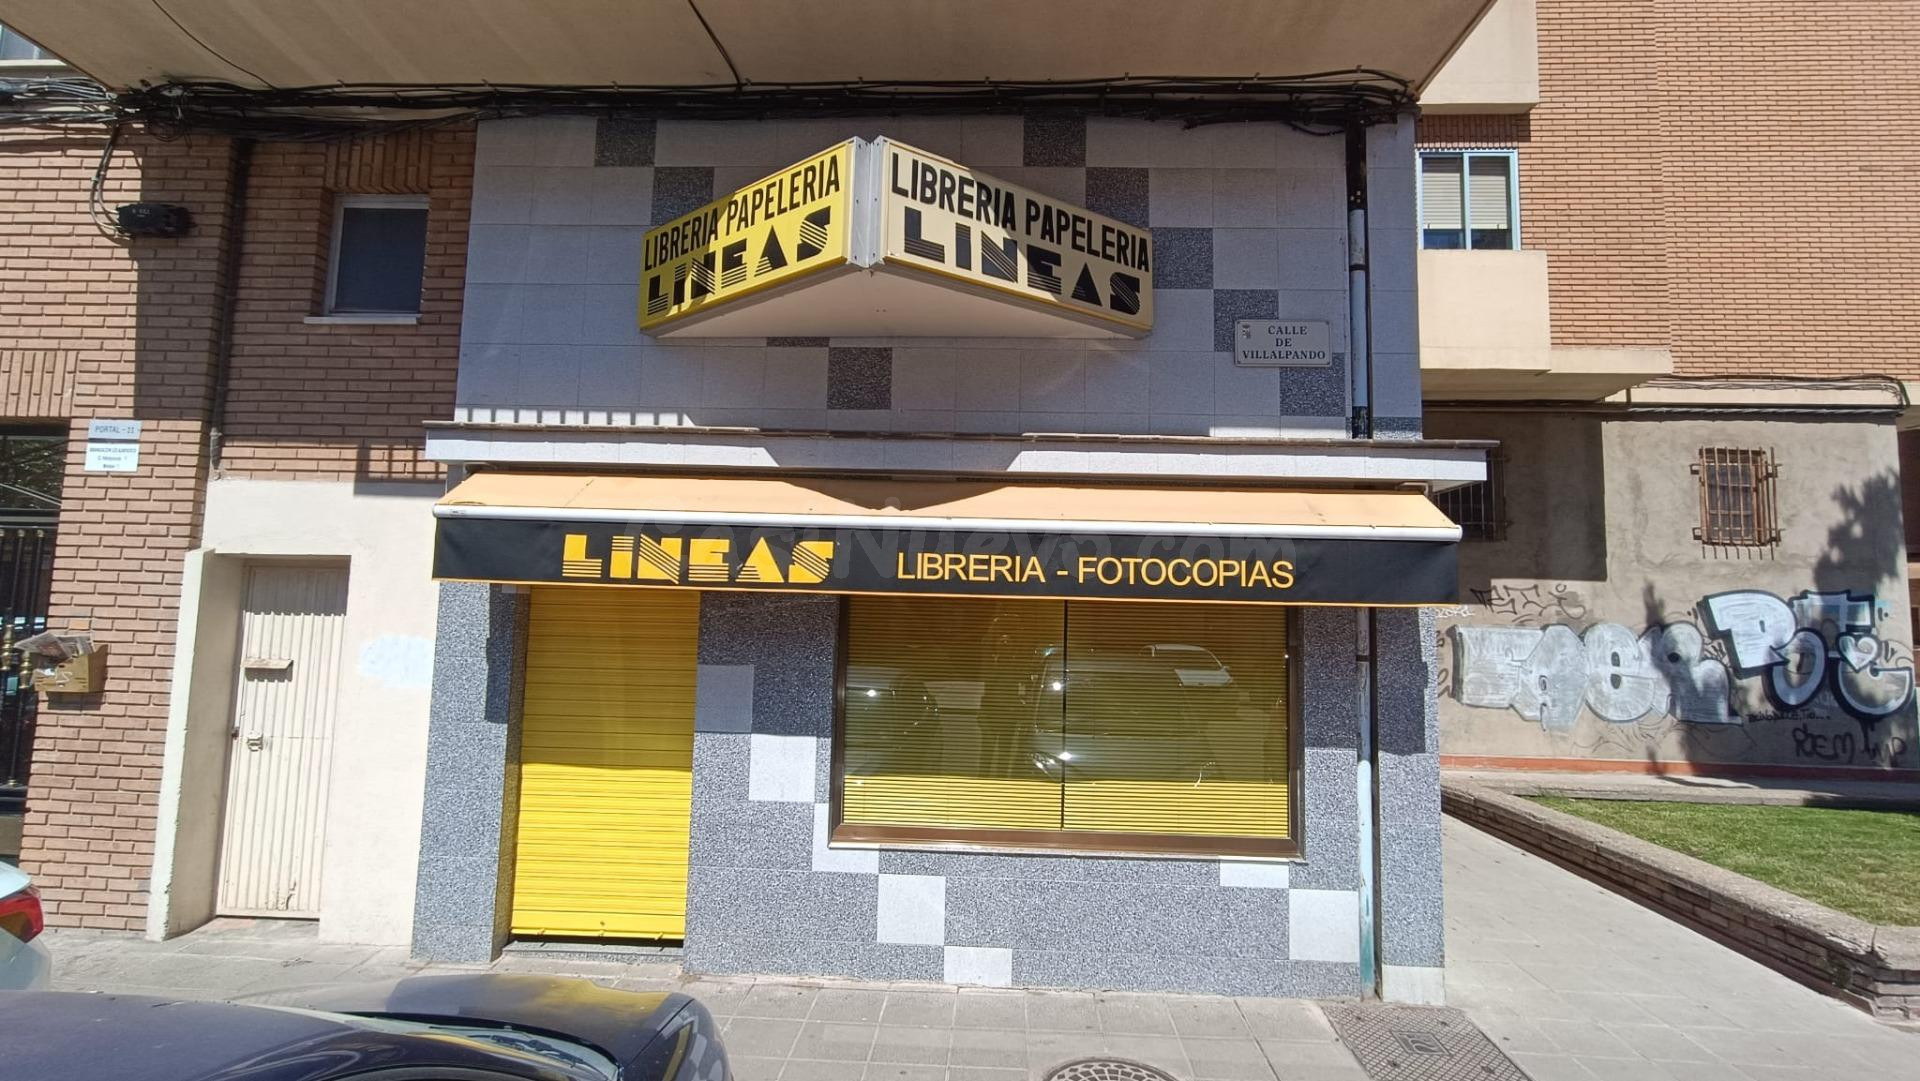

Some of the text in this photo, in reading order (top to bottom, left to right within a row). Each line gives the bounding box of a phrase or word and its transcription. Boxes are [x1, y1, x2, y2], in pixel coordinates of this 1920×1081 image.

[644, 154, 840, 272] LIBRERIA PAPELERIA
[891, 152, 1150, 273] LIBRERIA PAPELERIA
[647, 205, 832, 316] LINEAS
[904, 205, 1141, 316] LINEAS
[1242, 350, 1326, 360] VILLALPANDO
[1267, 325, 1308, 336] CALLE
[1275, 337, 1293, 347] DE
[95, 425, 121, 434] PORTAL
[561, 533, 835, 585] LINEAS
[896, 551, 1047, 584] LIBRERIA
[1077, 556, 1295, 589] FOTOCOPIAS
